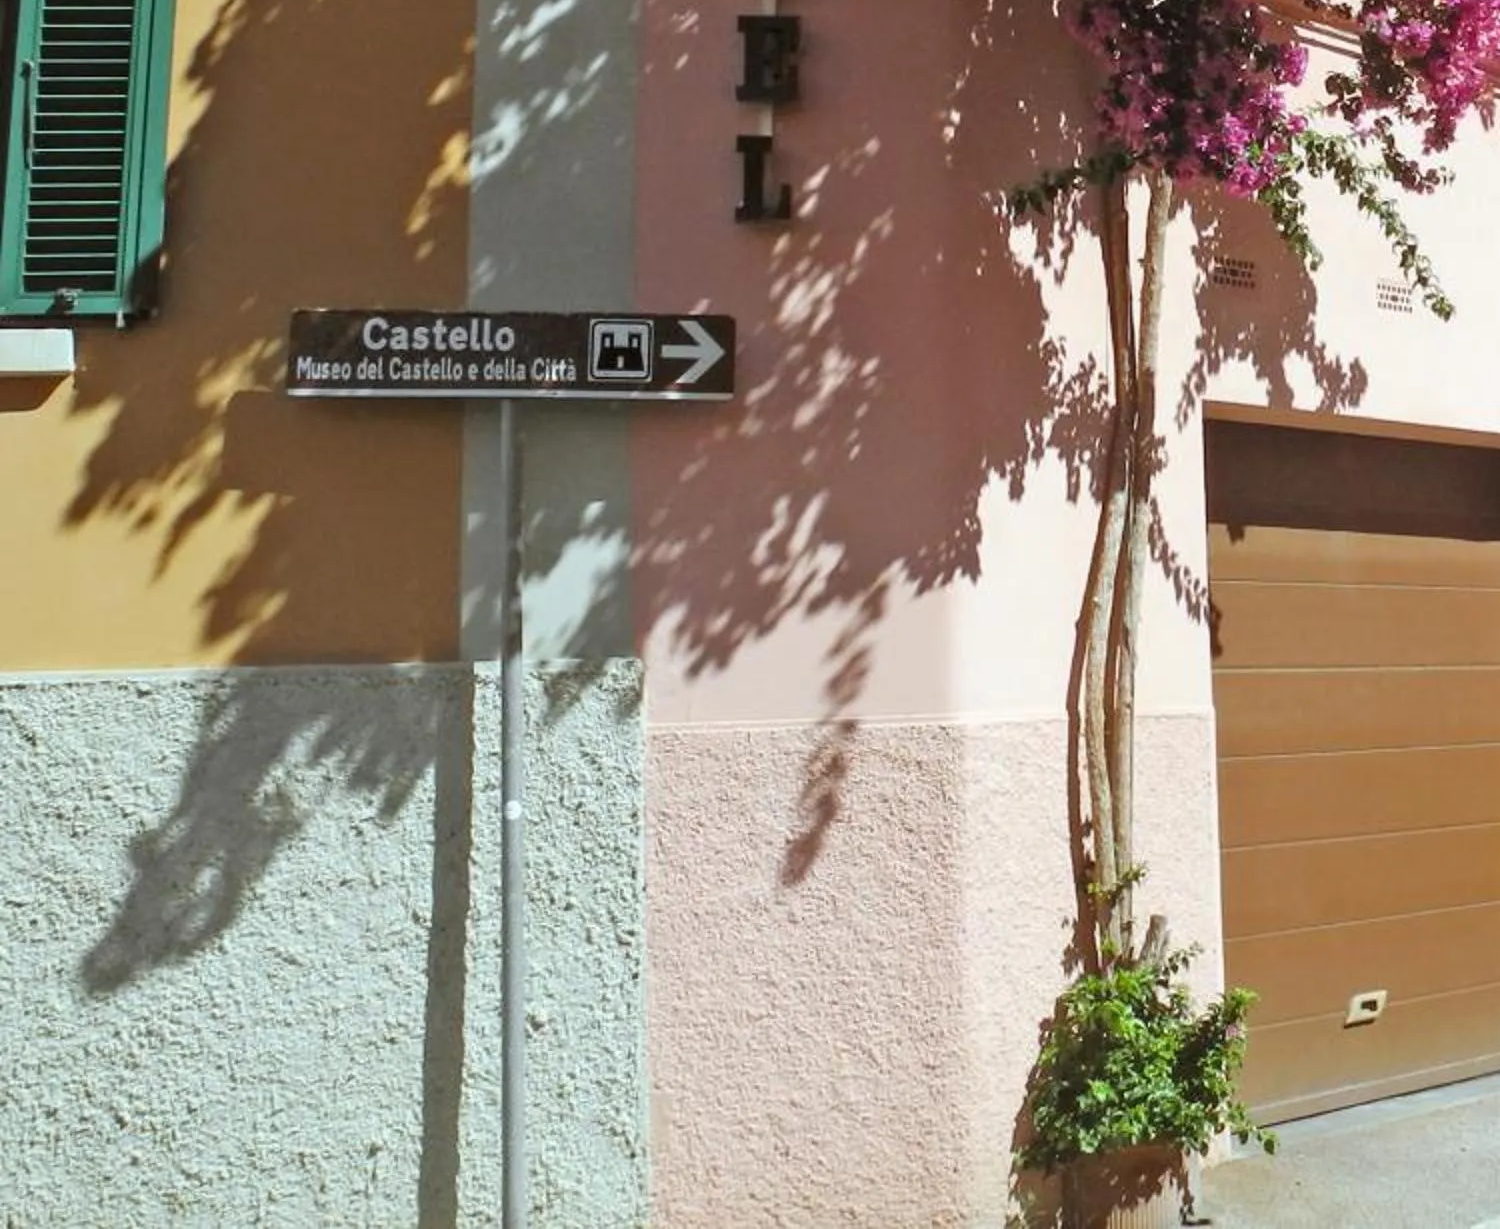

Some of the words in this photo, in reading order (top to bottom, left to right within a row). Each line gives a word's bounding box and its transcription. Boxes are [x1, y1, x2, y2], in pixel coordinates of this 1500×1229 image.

[363, 317, 515, 350] Castello
[297, 355, 352, 380] Museo
[357, 357, 384, 380] del
[389, 357, 463, 381] Castello
[467, 363, 479, 380] e
[483, 357, 527, 381] della
[530, 357, 577, 381] Città
